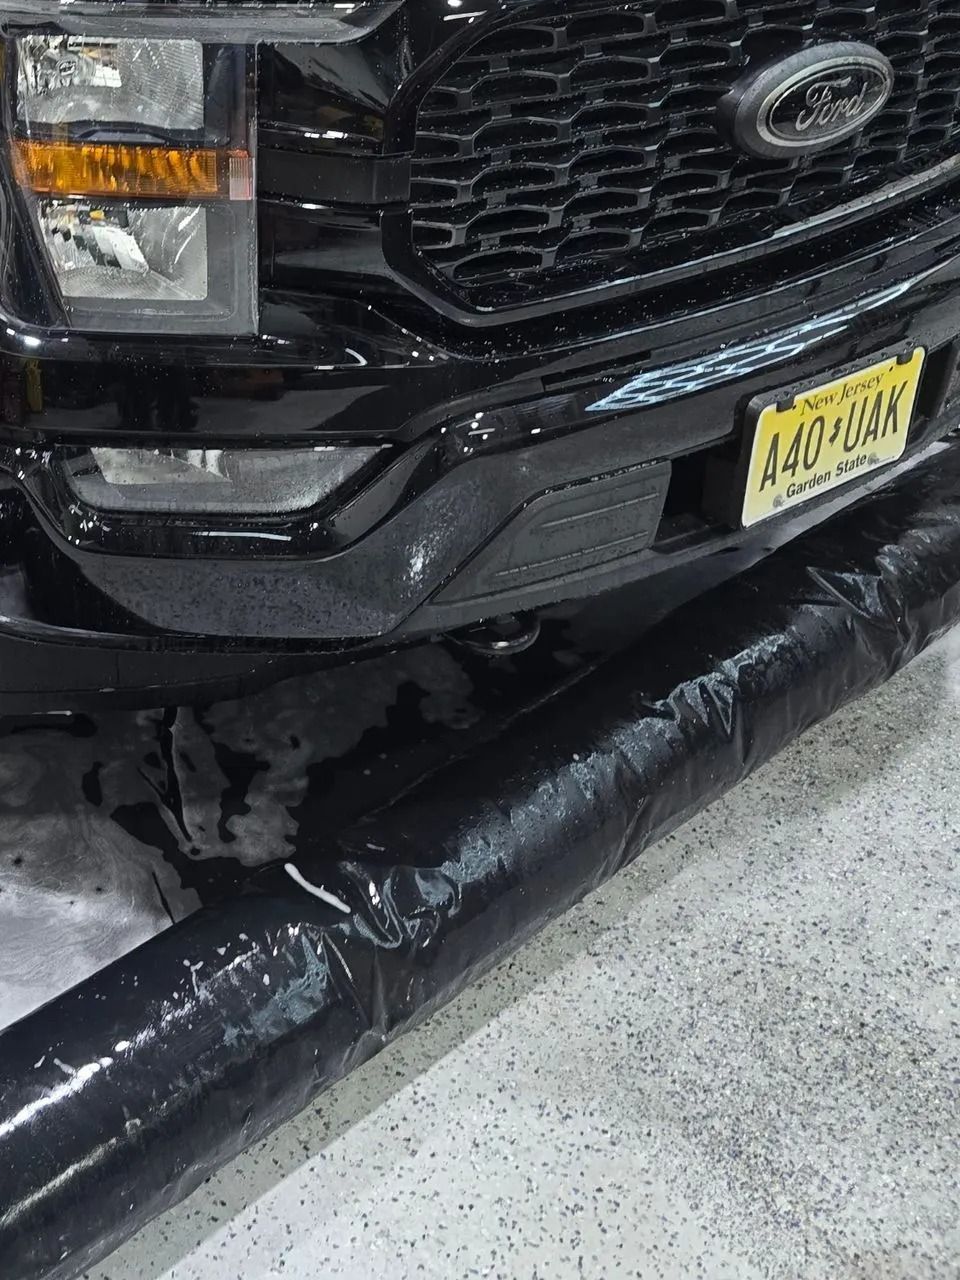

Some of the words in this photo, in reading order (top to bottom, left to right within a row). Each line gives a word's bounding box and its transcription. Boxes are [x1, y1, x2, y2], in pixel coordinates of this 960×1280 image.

[795, 76, 869, 131] Ford
[800, 393, 838, 416] New
[836, 373, 886, 406] Jersey
[786, 470, 831, 498] Garden
[836, 453, 868, 477] State
